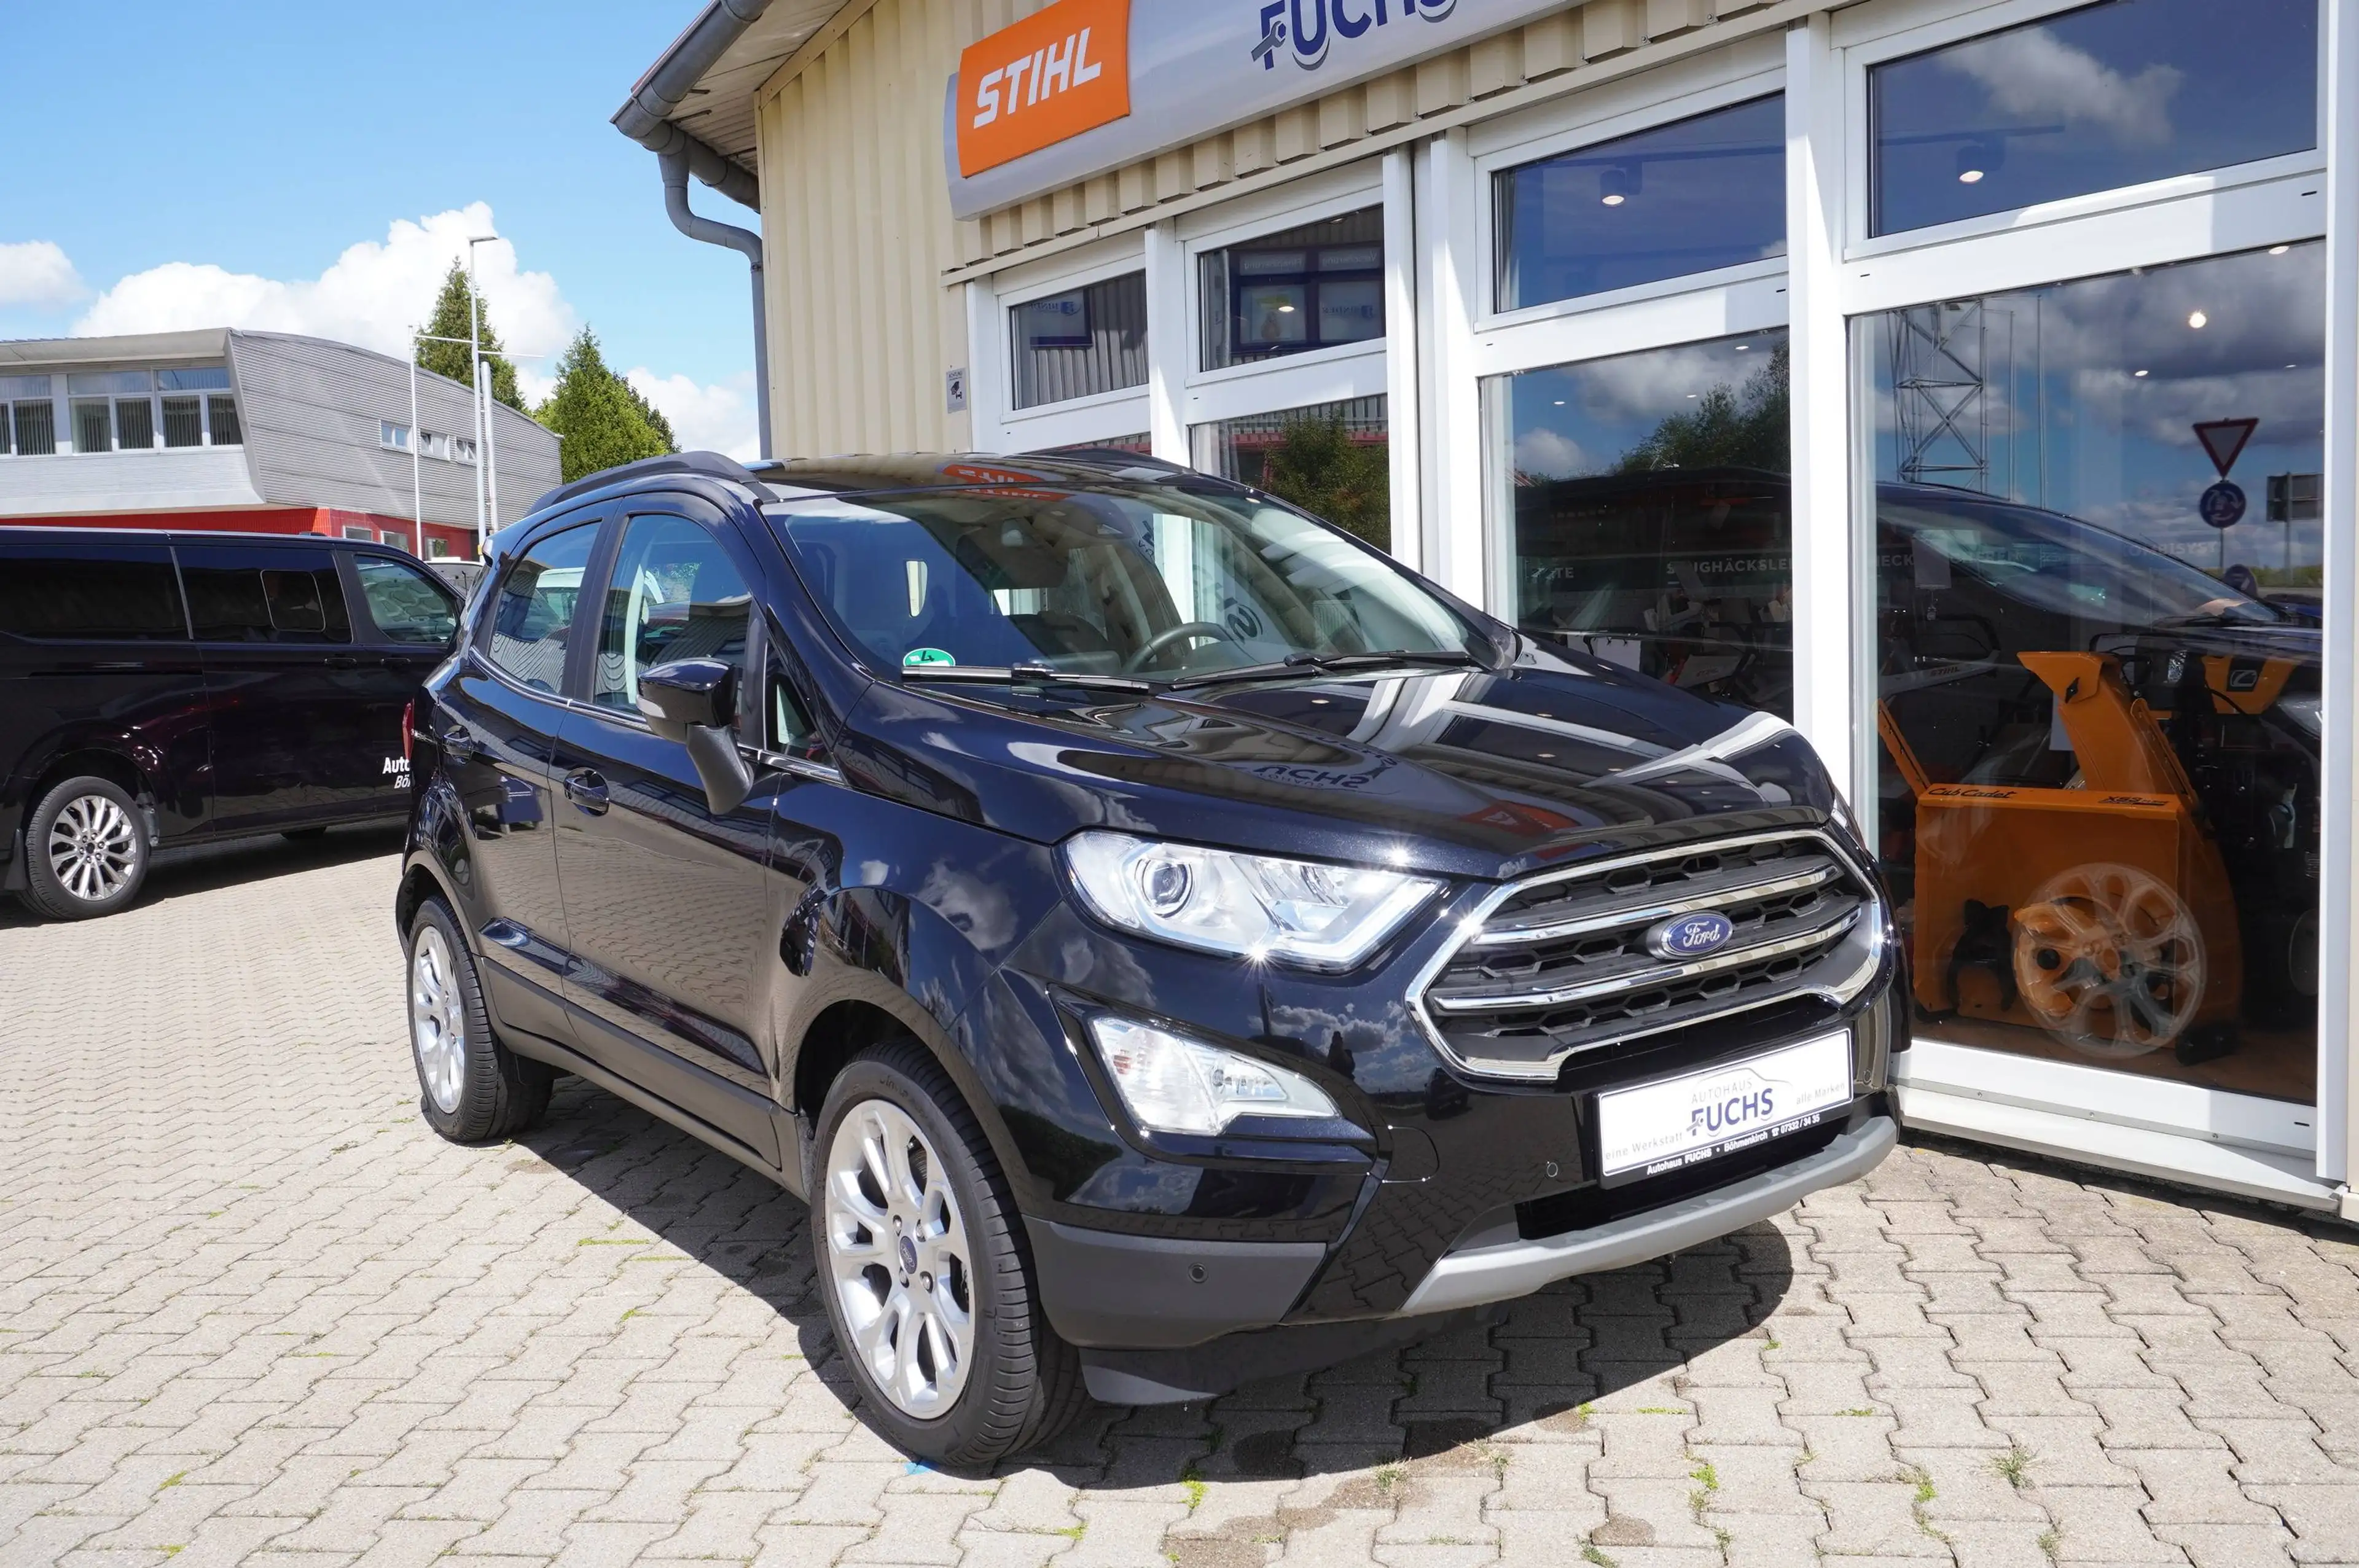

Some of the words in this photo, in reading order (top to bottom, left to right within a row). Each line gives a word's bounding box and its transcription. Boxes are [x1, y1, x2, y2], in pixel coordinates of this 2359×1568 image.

[1259, 0, 1447, 70] FUC
[973, 26, 1102, 128] STIHL
[1666, 558, 1792, 574] SGHÄCKSLE
[394, 774, 410, 789] Bö
[1683, 921, 1719, 947] Ford
[1692, 1078, 1752, 1104] AUTOHAUS
[1796, 1091, 1812, 1104] alle
[1815, 1083, 1845, 1098] Marken
[1691, 1088, 1774, 1136] FUCHS
[1606, 1147, 1628, 1160] eine
[1632, 1132, 1682, 1152] Werkstatt
[1646, 1158, 1682, 1175] Autohaus
[1684, 1148, 1713, 1163] FUCHS
[1724, 1131, 1768, 1152] Böhmenkirch
